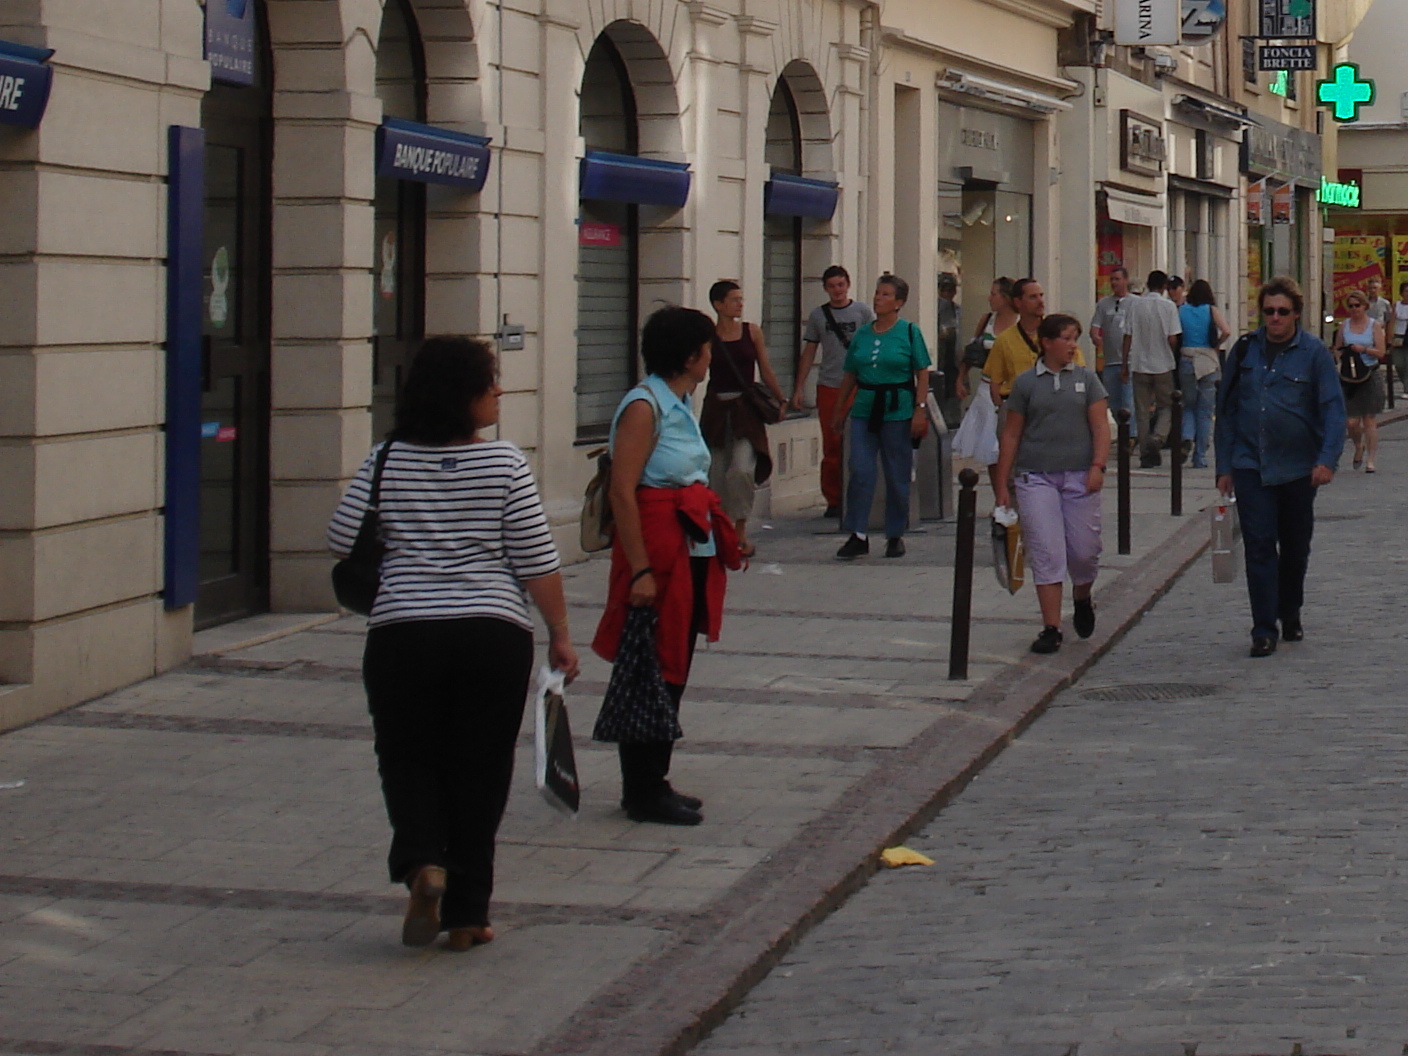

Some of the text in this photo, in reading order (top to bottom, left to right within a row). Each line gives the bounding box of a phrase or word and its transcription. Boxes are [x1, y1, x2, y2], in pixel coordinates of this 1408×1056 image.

[1263, 48, 1312, 58] FONCIA
[1263, 58, 1312, 68] BRETTE
[393, 143, 480, 179] BANQUE POPULAIRE
